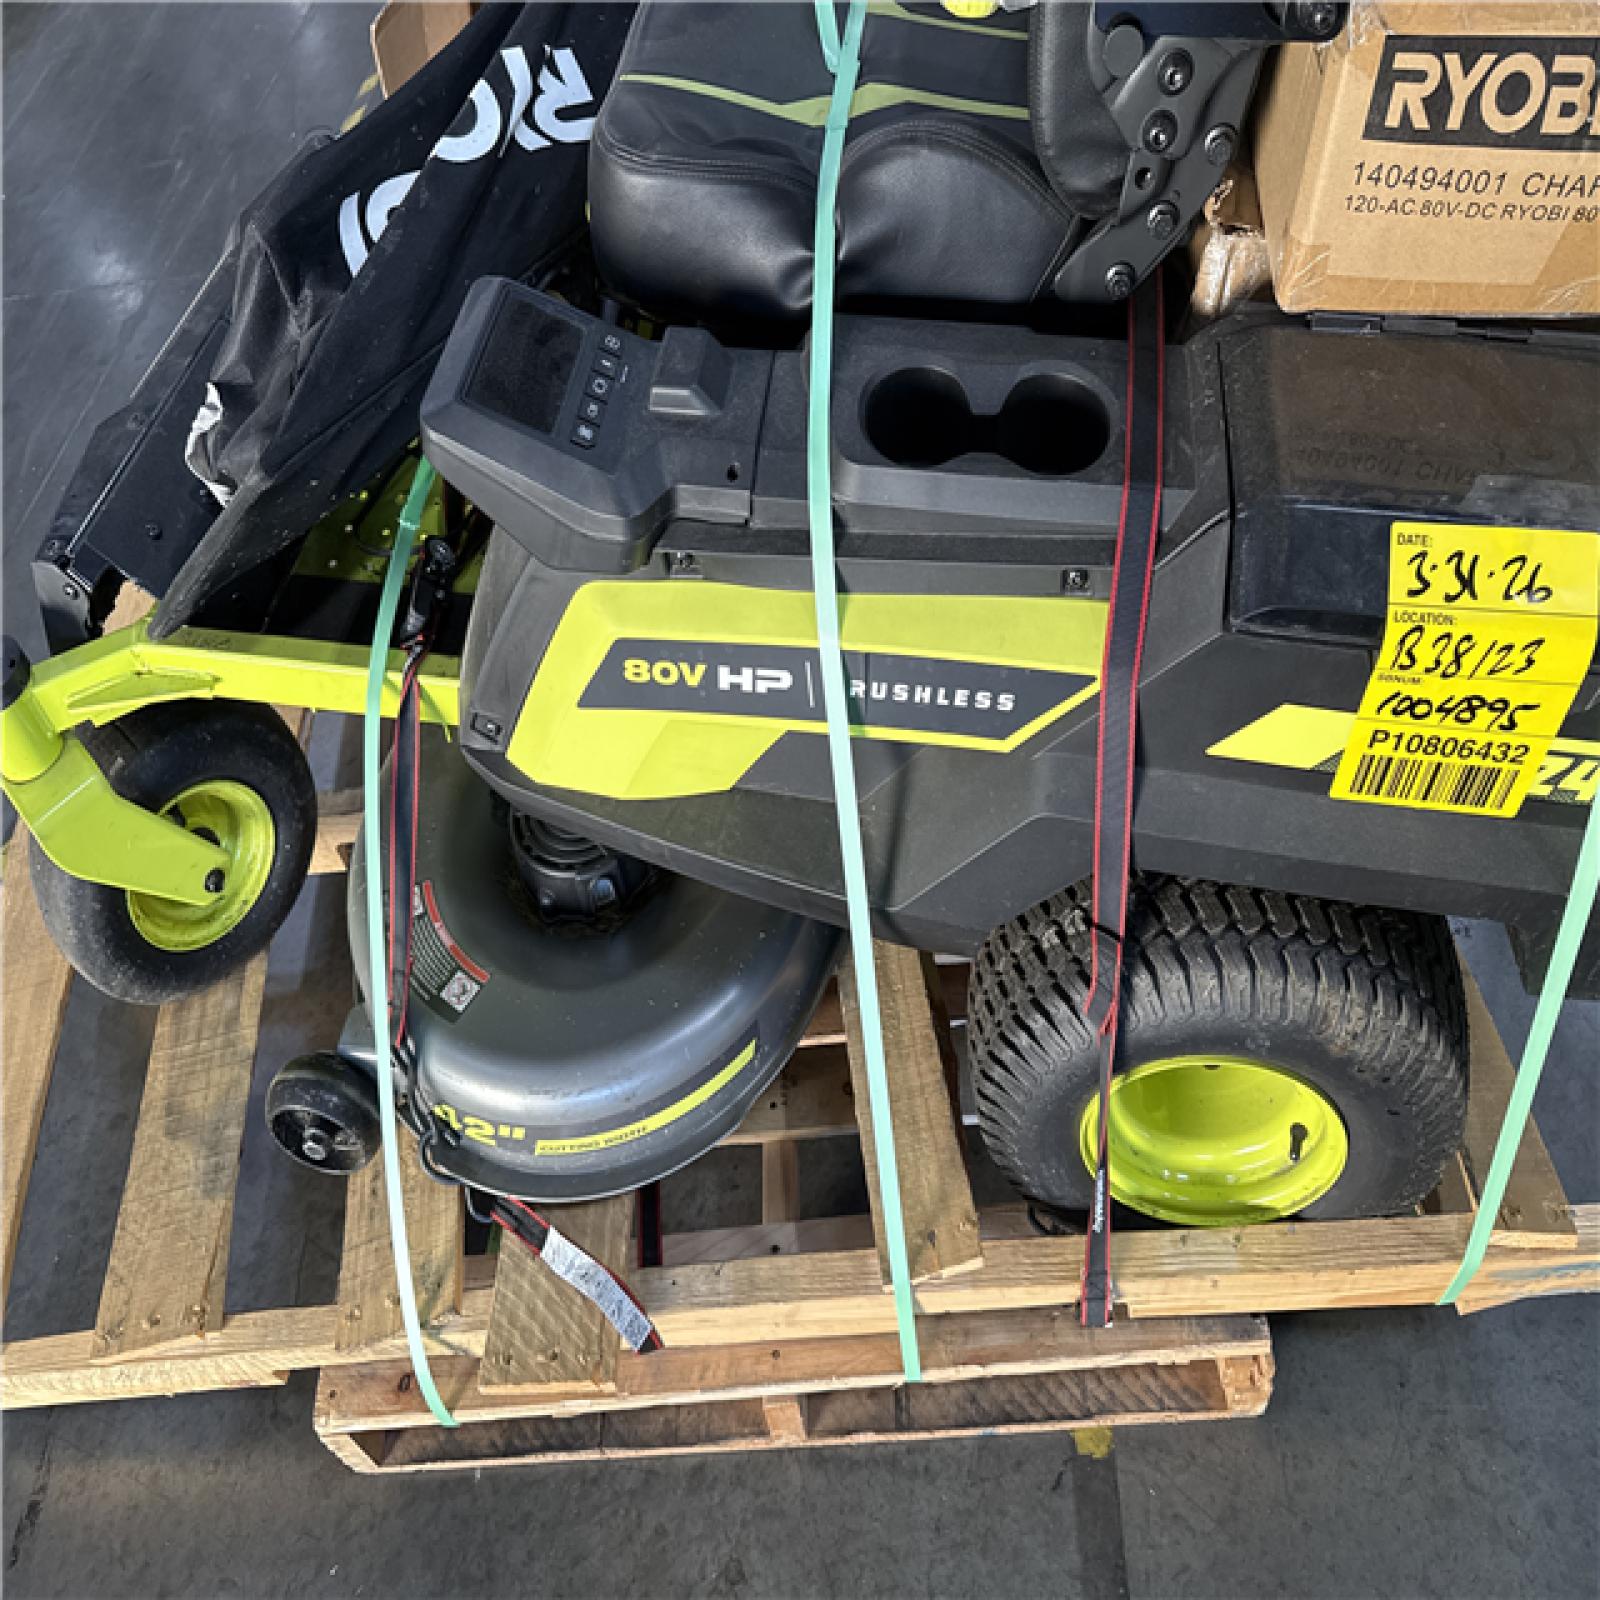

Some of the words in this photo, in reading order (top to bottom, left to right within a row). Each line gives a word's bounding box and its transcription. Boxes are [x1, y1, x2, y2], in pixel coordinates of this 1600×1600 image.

[1354, 161, 1508, 195] 140494001
[1396, 532, 1433, 548] DATE:
[1394, 610, 1458, 627] LOCATION:
[624, 658, 708, 688] 80V
[717, 663, 793, 694] HP
[849, 678, 1015, 712] RUSHLESS
[1367, 729, 1531, 766] P10806432
